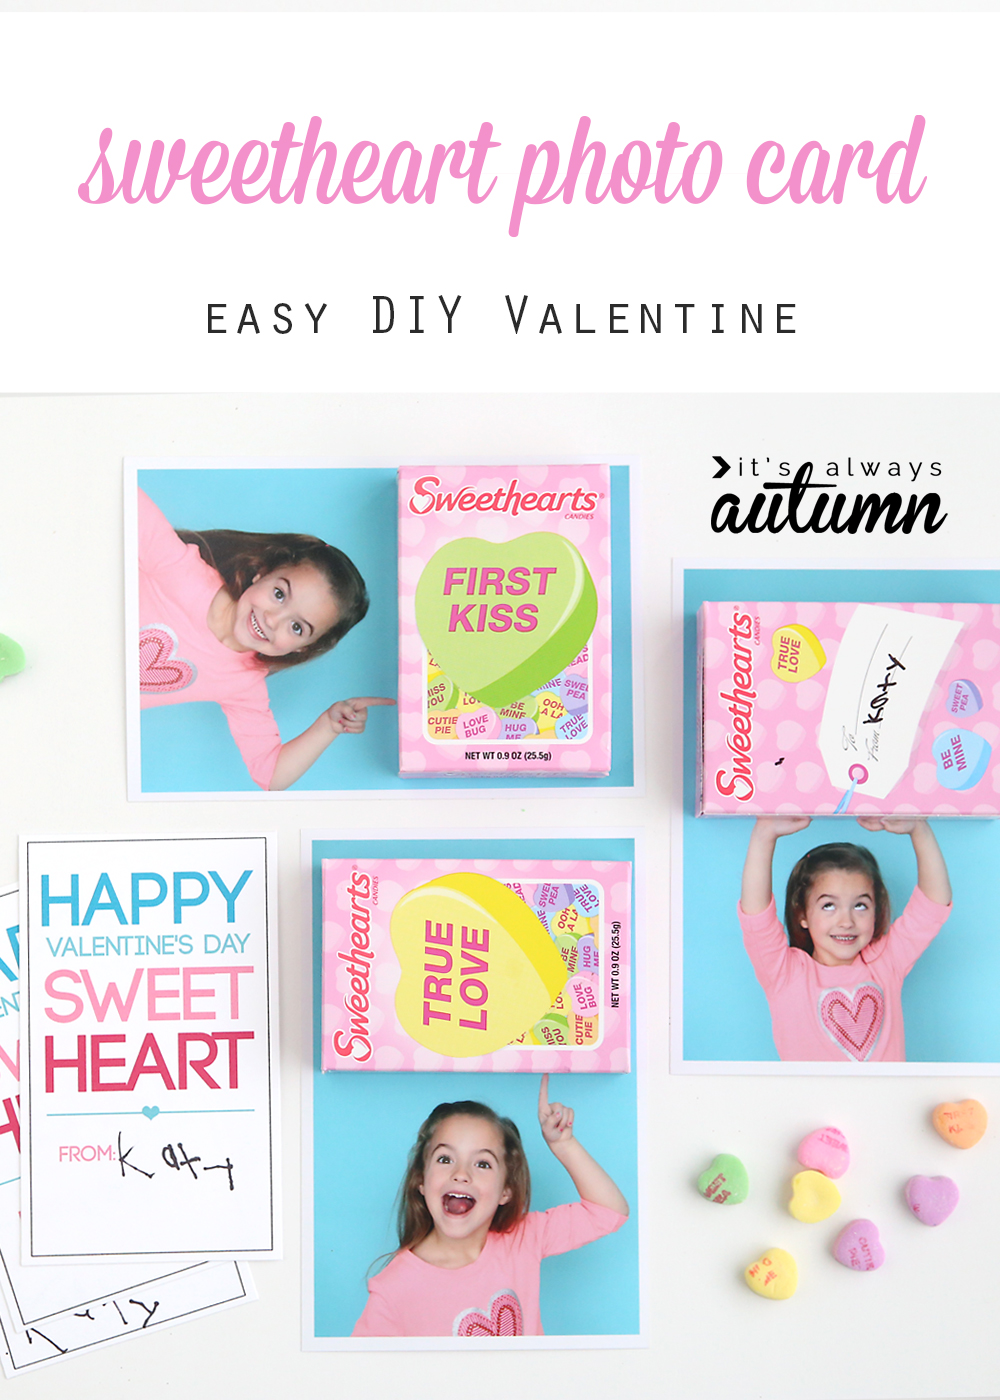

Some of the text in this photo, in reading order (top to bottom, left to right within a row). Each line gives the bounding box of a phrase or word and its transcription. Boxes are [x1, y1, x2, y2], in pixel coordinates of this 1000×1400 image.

[409, 475, 597, 515] Sweethearts
[443, 567, 557, 595] FIRST
[448, 604, 539, 632] KISS
[778, 636, 790, 670] TRUE
[788, 639, 801, 673] LOVE
[543, 699, 564, 711] OOH
[566, 690, 586, 700] PEA
[715, 612, 757, 801] Sweethearts
[951, 683, 963, 713] SWEET
[959, 694, 969, 711] PEA
[428, 717, 457, 725] CUTIE
[435, 726, 451, 734] PIE
[463, 714, 489, 729] LOVE
[465, 726, 486, 738] BUG
[505, 724, 526, 732] HUG
[560, 714, 583, 733] TRUE
[524, 752, 551, 761] (25.5g)
[941, 749, 953, 770] BE
[951, 735, 967, 772] MINE
[42, 870, 252, 927] HAPPY
[548, 886, 559, 905] PEA
[558, 908, 570, 929] OOH
[47, 933, 250, 957] VALENTINE'S DAY
[612, 921, 621, 949] (25.5g)
[333, 871, 374, 1062] Sweethearts
[583, 946, 591, 967] HUG
[612, 951, 620, 962] OZ
[423, 919, 453, 1026] TRUE
[459, 925, 489, 1031] LOVE
[44, 966, 254, 1024] SWEET
[611, 978, 619, 991] WT
[573, 983, 587, 1010] LOVE
[584, 986, 597, 1008] BUG
[575, 1014, 583, 1045] CUTIE
[44, 1031, 255, 1093] HEART
[59, 1145, 116, 1163] FROM:
